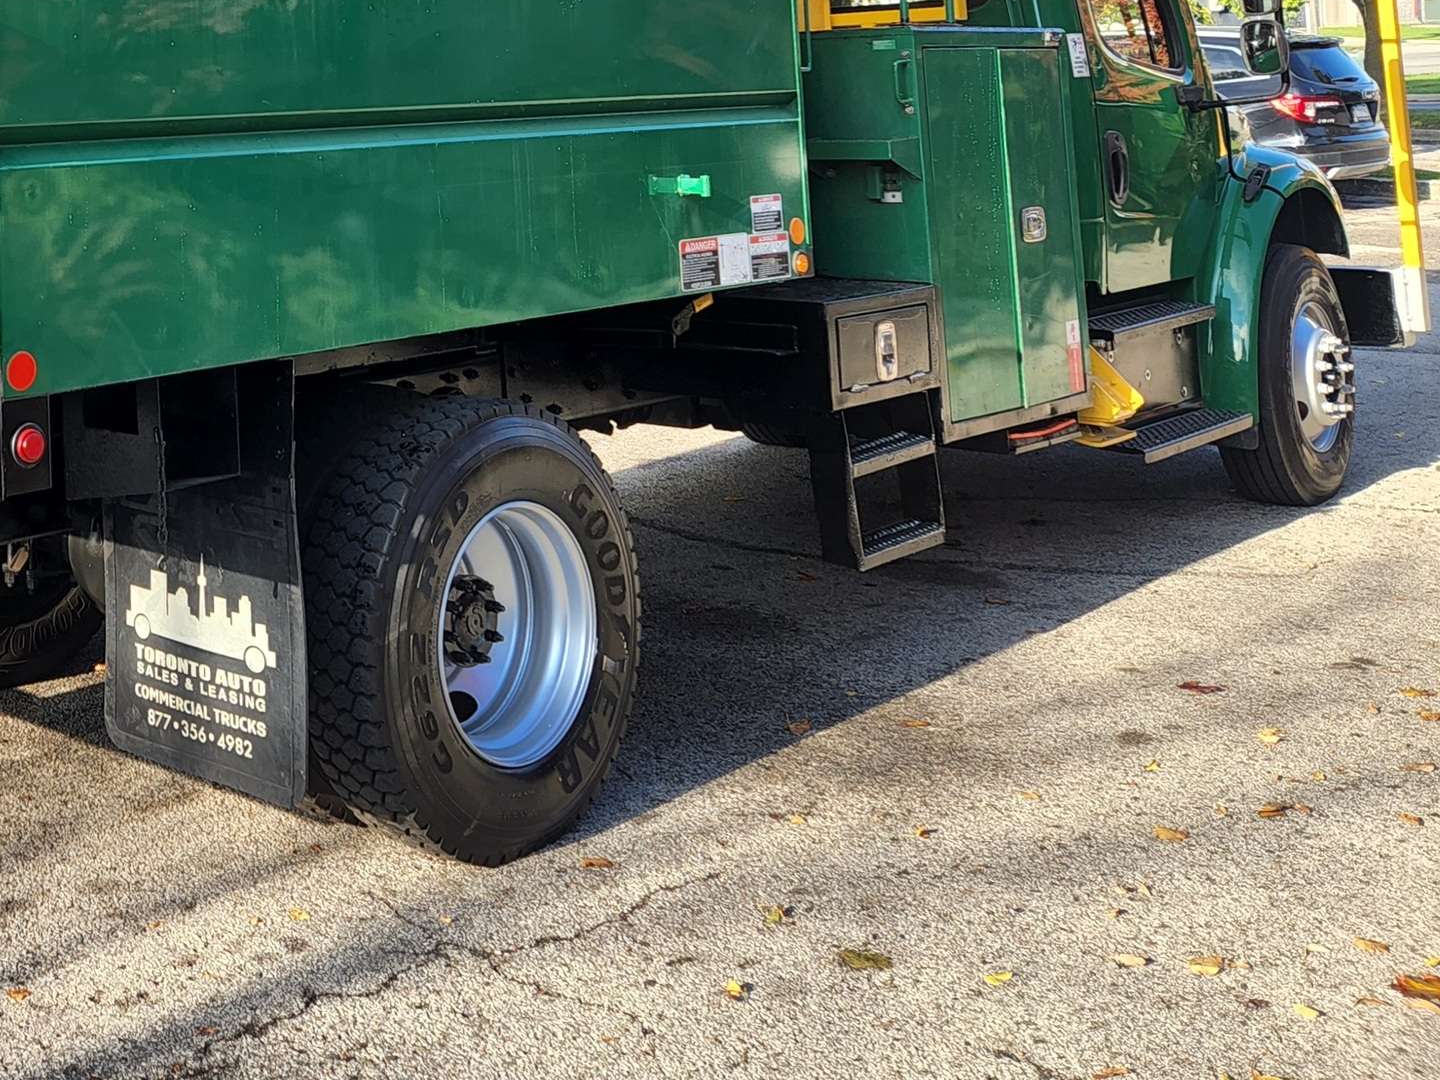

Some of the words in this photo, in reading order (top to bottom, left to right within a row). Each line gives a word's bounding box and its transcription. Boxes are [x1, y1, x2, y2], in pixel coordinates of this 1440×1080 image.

[558, 484, 628, 793] GOODYEAR
[135, 642, 211, 681] TORONTO
[215, 668, 266, 697] AUTO
[136, 661, 179, 686] SALES
[184, 677, 194, 691] &
[199, 681, 266, 712] LEASING
[134, 682, 211, 721] COMMERCIAL
[212, 707, 267, 738] TRUCKS
